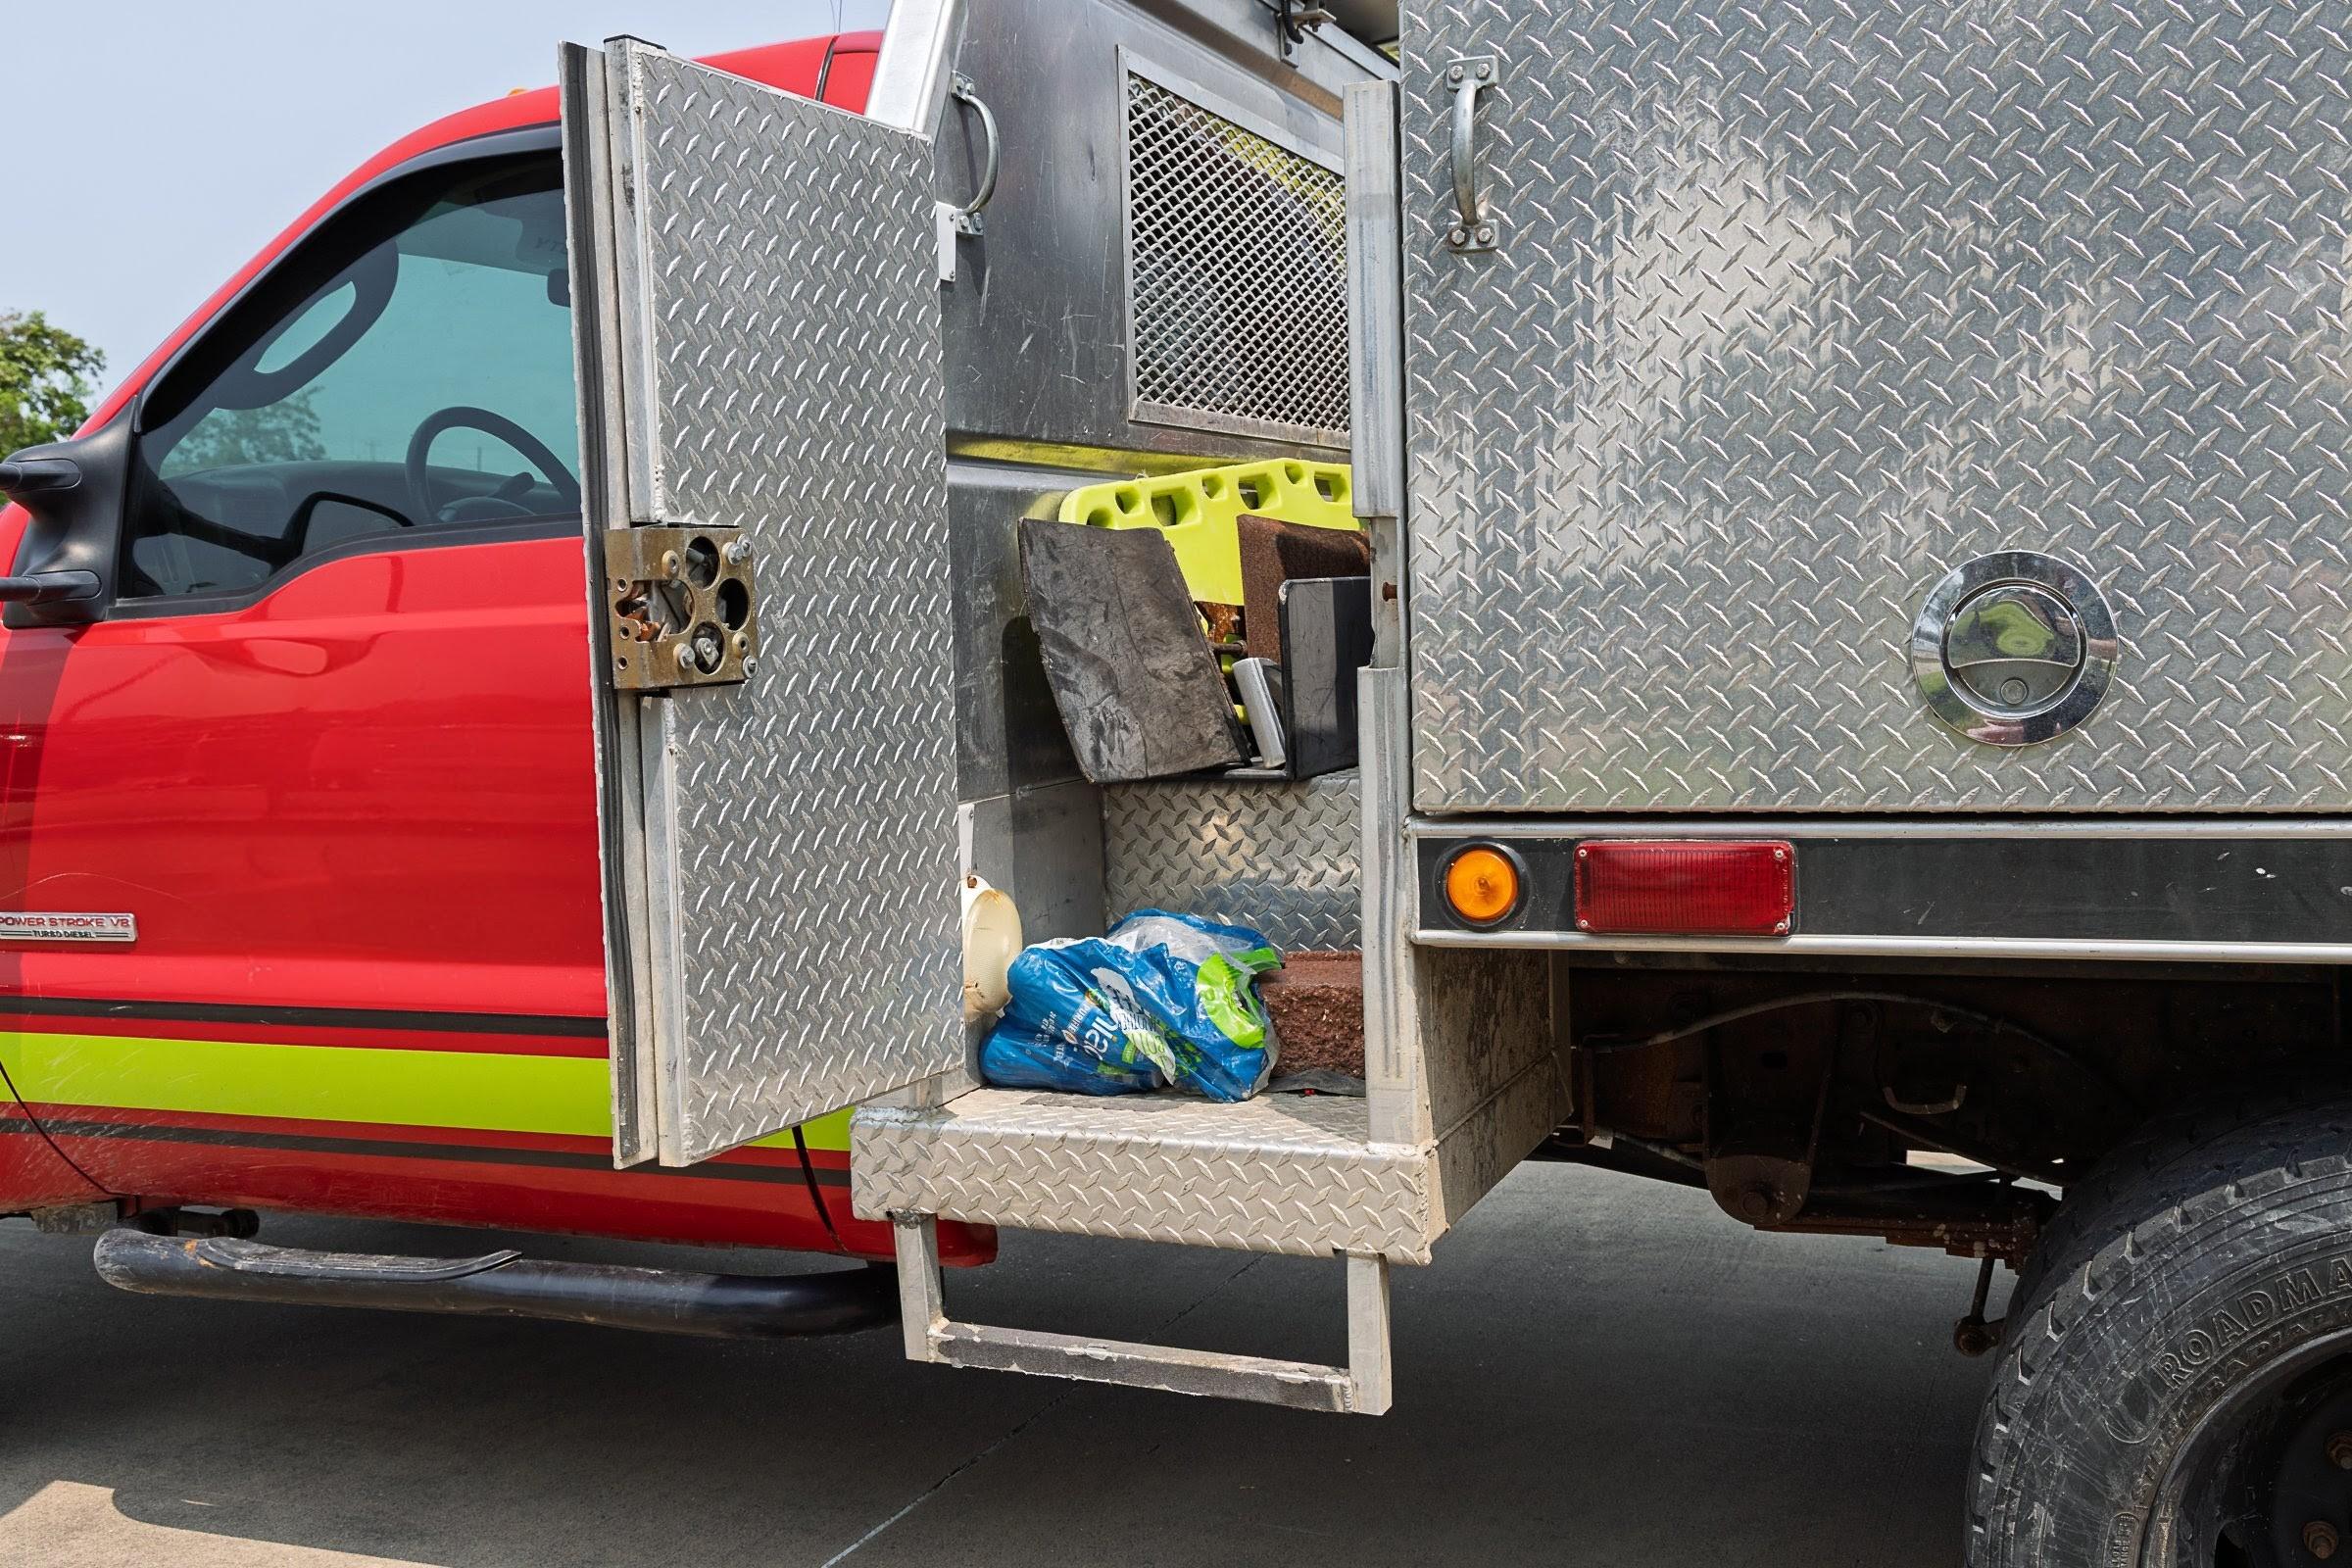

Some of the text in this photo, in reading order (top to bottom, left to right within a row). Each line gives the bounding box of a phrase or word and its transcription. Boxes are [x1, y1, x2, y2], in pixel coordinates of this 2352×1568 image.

[0, 917, 130, 927] POWER STROKE V8
[1066, 1000, 1092, 1034] PURIFIE
